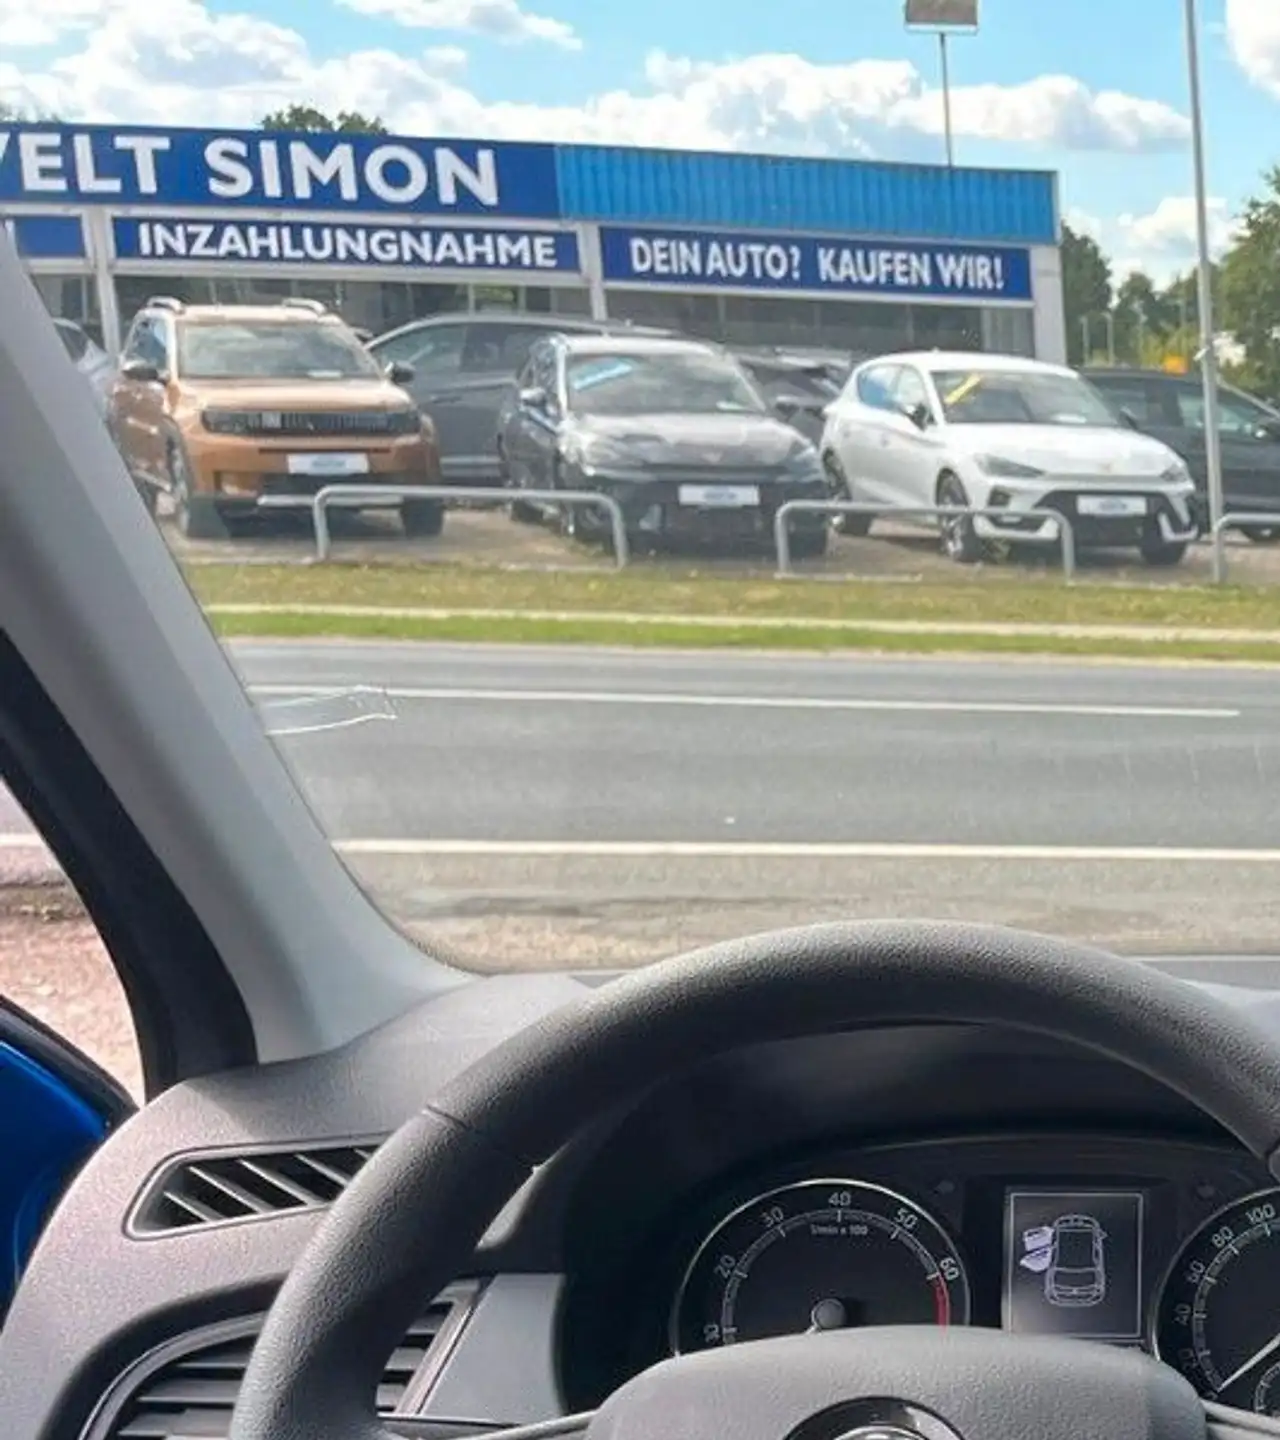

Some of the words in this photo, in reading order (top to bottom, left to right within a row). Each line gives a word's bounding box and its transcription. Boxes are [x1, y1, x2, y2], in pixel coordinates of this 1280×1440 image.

[0, 133, 170, 194] ELT
[204, 137, 499, 206] SIMON
[138, 222, 557, 268] INZAHLUNGNAHME
[630, 237, 700, 276] DEIN
[706, 241, 801, 282] AUTO?
[817, 246, 931, 288] KAUFEN
[936, 253, 1003, 290] WIR!
[828, 1191, 852, 1207] 40
[894, 1207, 918, 1230] 50
[1244, 1203, 1276, 1225] 100
[1211, 1225, 1234, 1249] 80
[939, 1256, 960, 1281] 60
